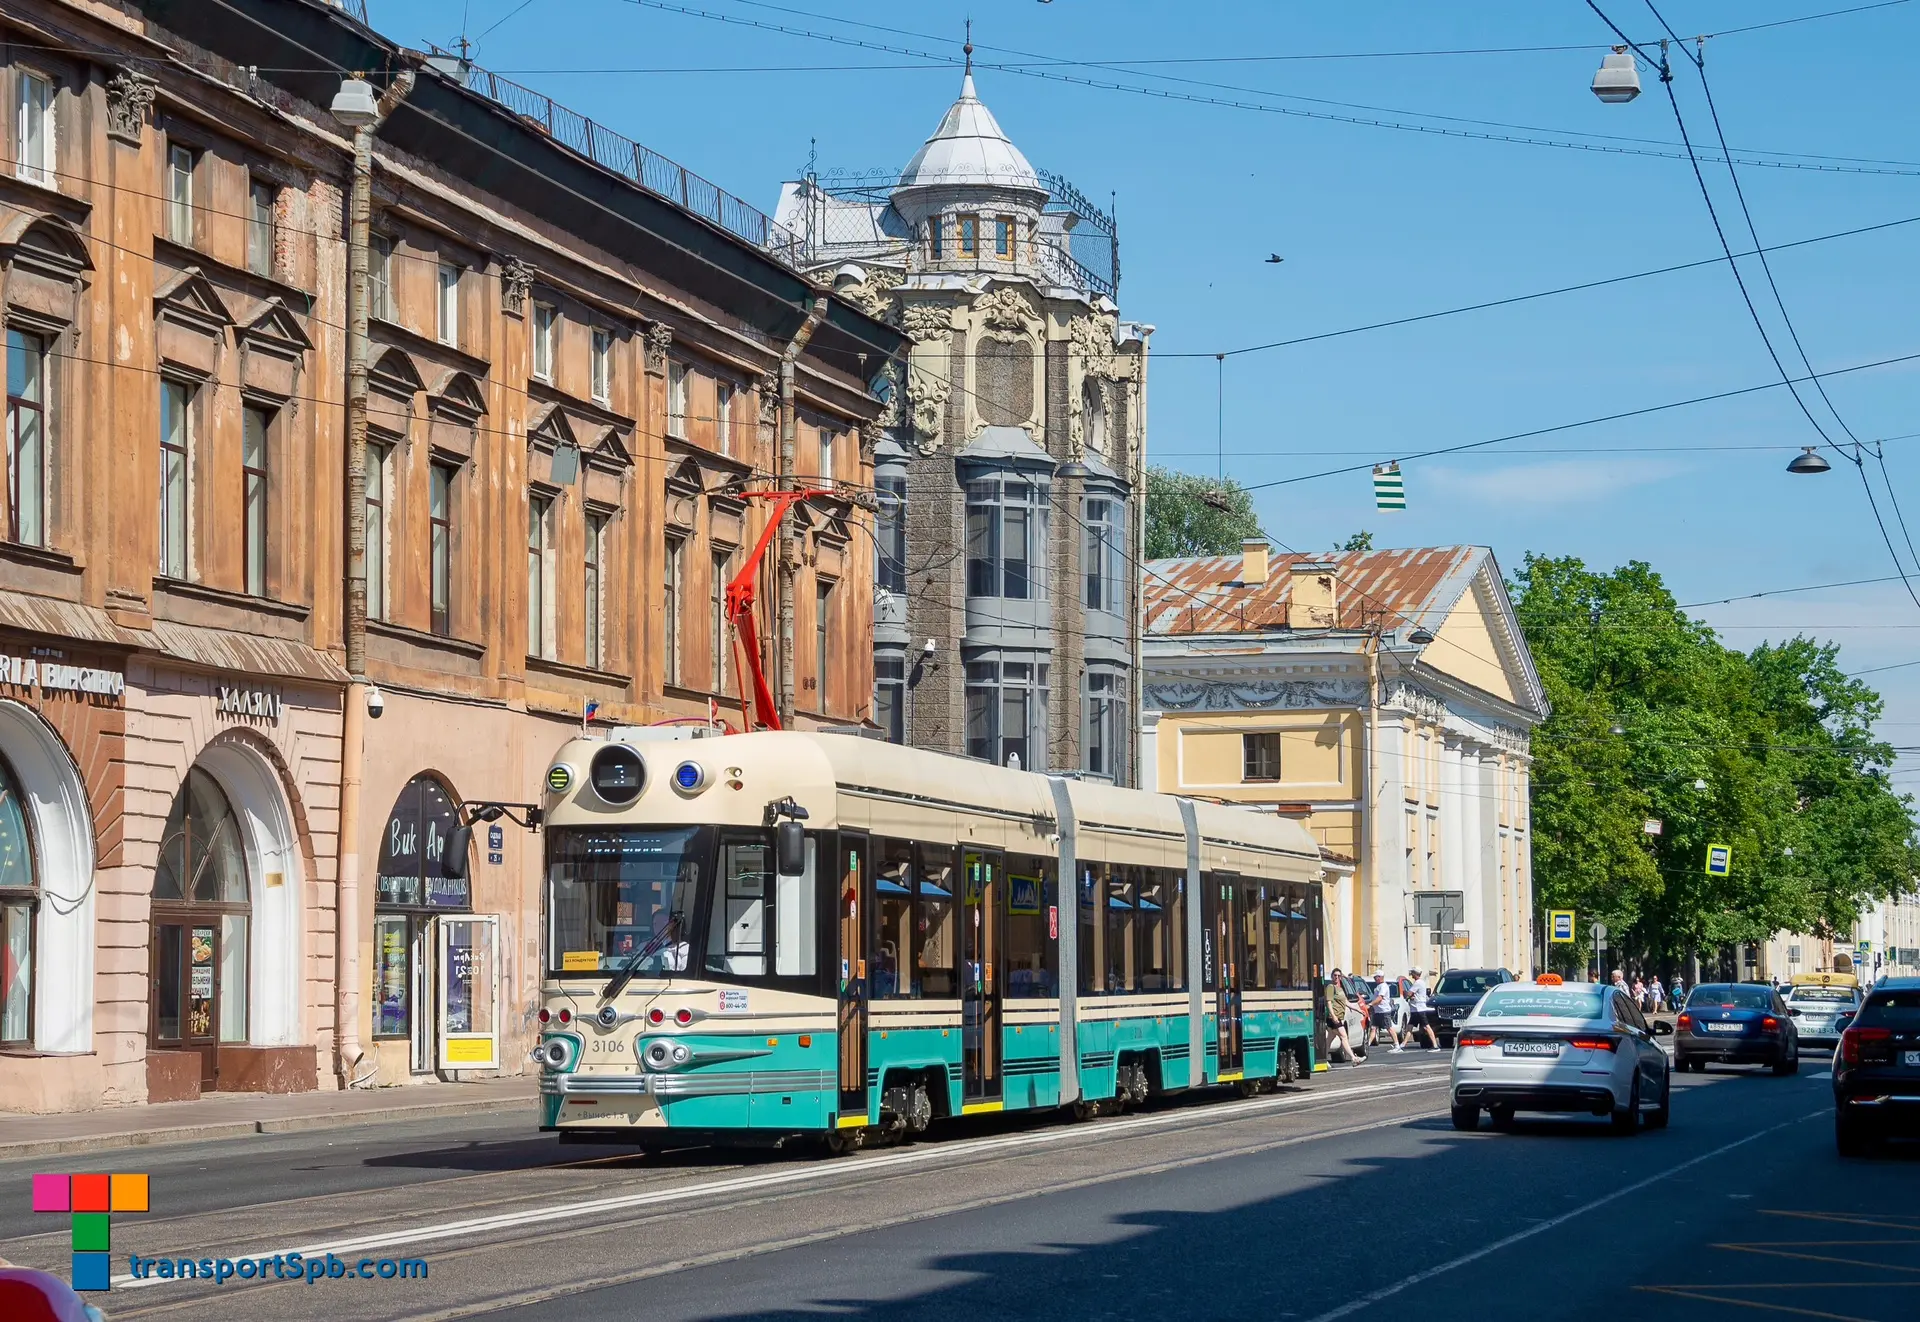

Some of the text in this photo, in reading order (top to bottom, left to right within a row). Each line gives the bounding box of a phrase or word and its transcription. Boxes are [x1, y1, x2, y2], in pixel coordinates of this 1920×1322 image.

[220, 686, 284, 718] ХАЛЯЛЬ
[391, 818, 445, 863] Вик Ар
[592, 1040, 625, 1053] 3106
[1507, 1043, 1557, 1053] Т490КО 198
[583, 1110, 612, 1119] Вынос
[613, 1110, 625, 1120] 1,5
